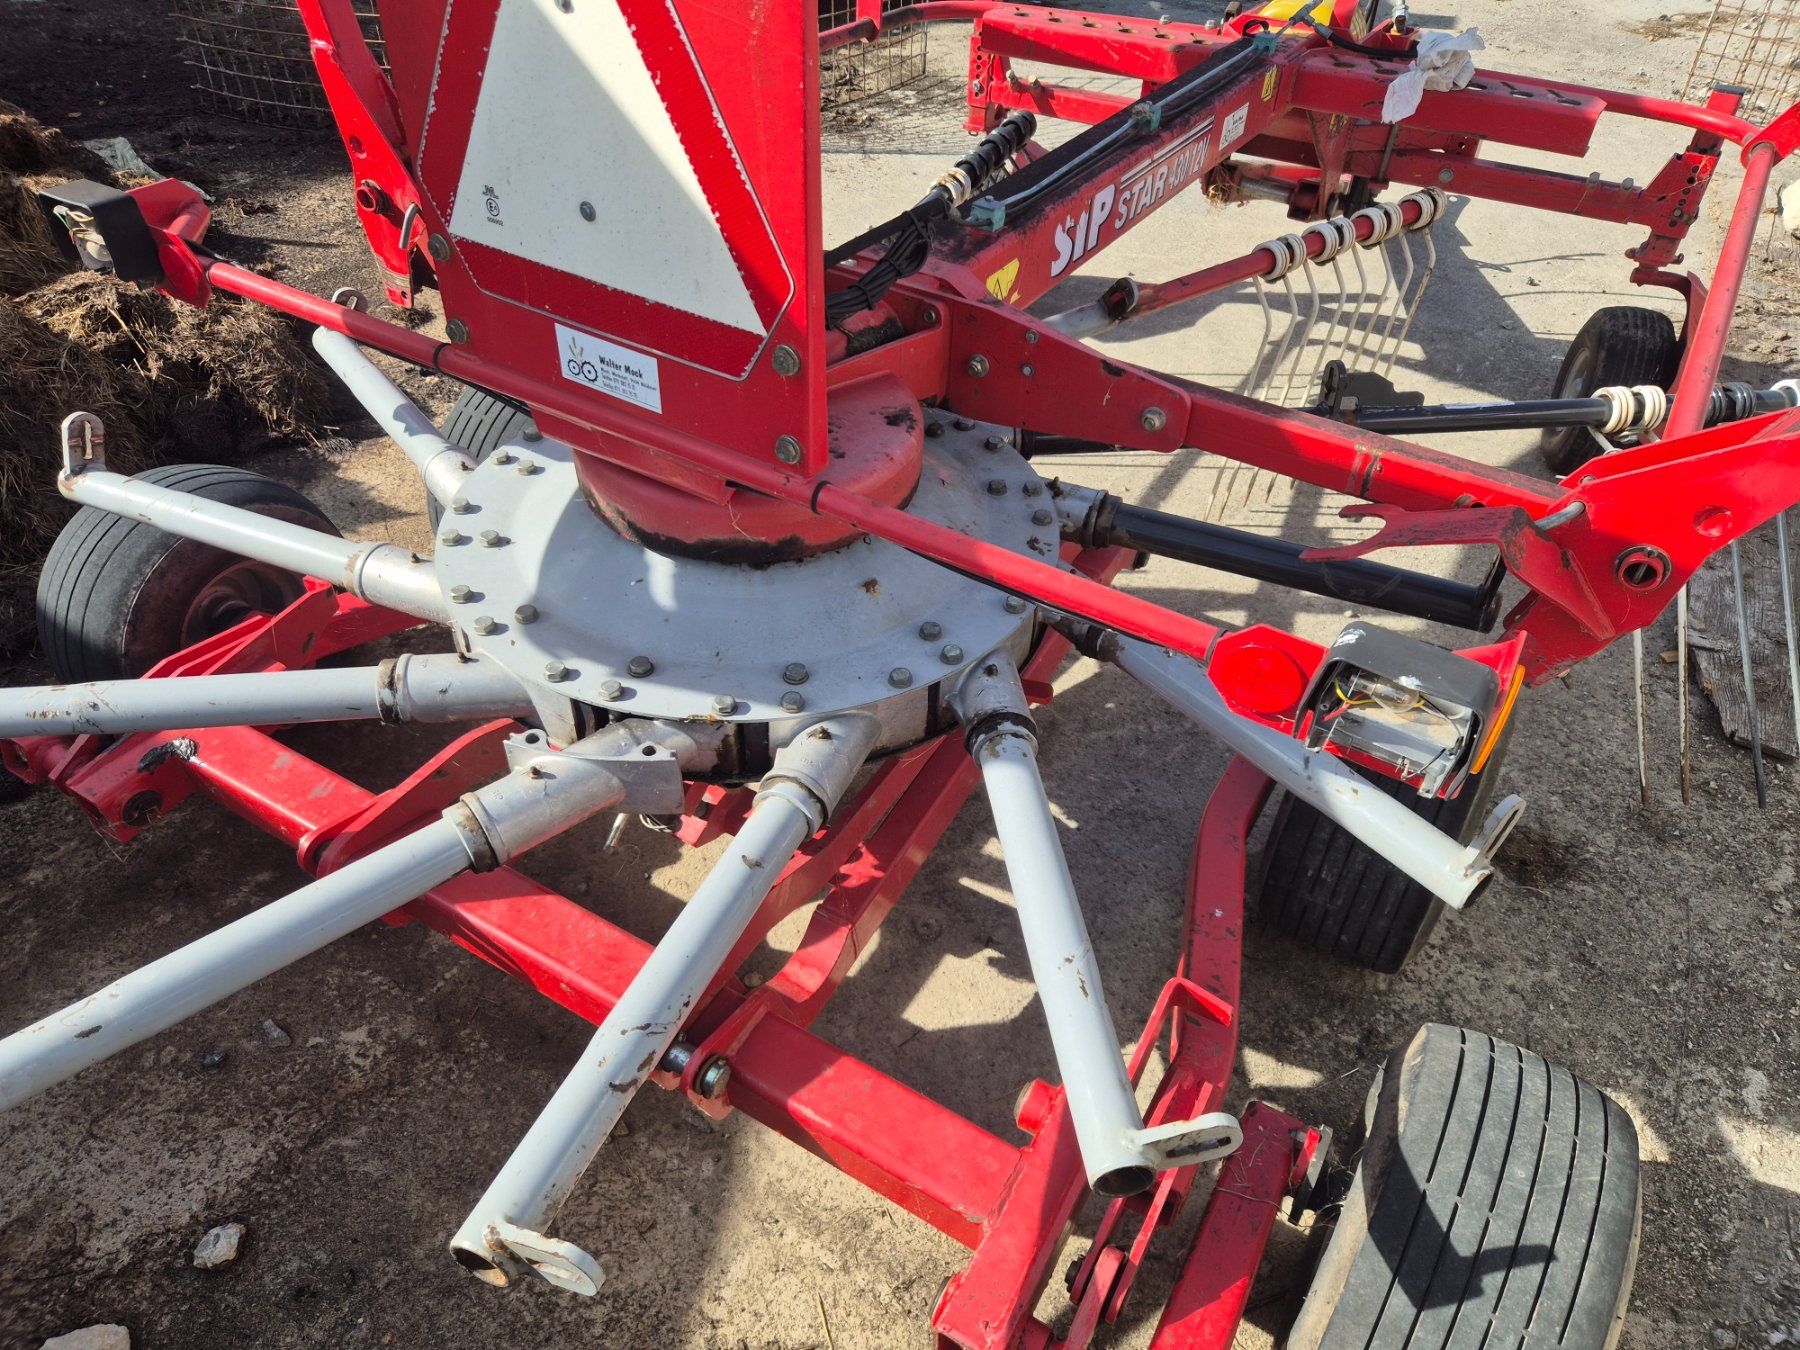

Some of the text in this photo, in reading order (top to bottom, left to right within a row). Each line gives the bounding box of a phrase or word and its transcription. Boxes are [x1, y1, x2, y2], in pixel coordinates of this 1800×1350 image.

[1051, 184, 1116, 278] SIP
[1115, 164, 1169, 230] STAR
[598, 355, 622, 371] Walter
